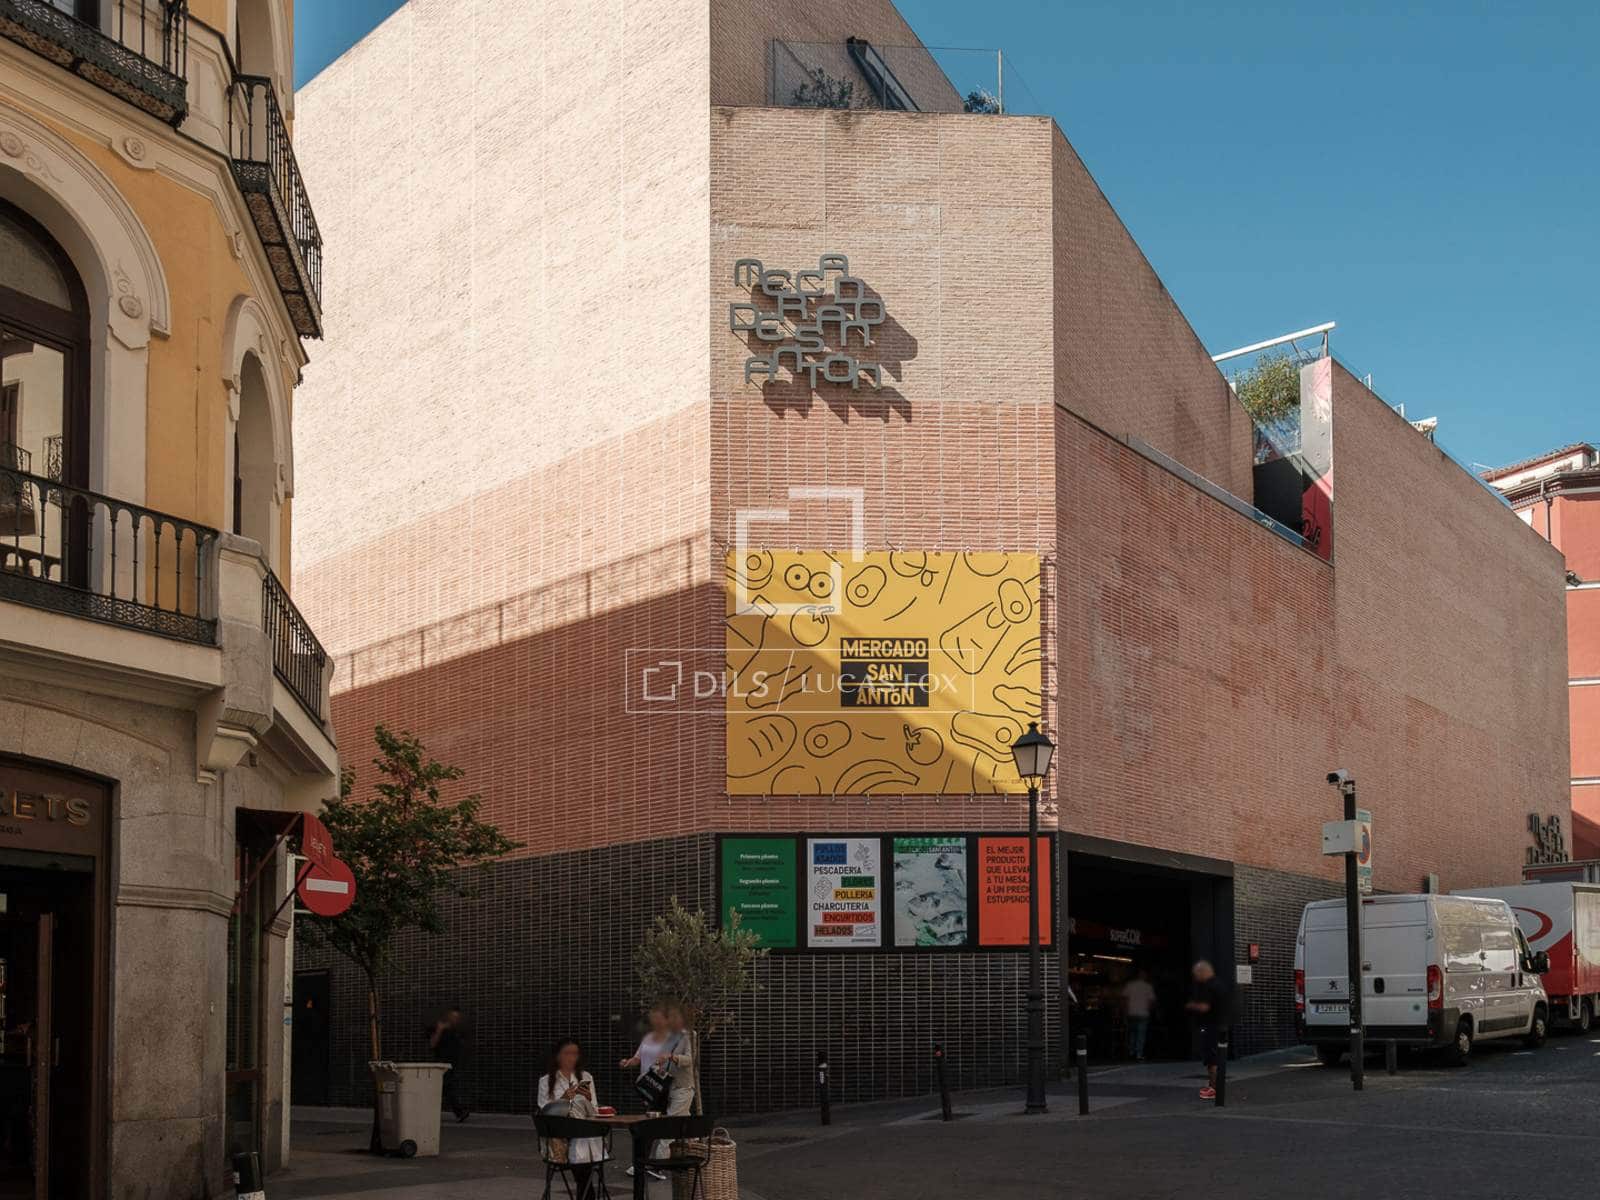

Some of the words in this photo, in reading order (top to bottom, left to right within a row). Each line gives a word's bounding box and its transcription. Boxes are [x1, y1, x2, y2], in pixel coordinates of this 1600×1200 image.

[843, 640, 926, 658] MERCADO
[868, 664, 902, 681] SAN
[986, 856, 1026, 864] PRODUCTO
[986, 866, 1001, 874] QUE
[994, 876, 1004, 884] TU
[986, 886, 992, 894] A
[994, 886, 1005, 894] UN
